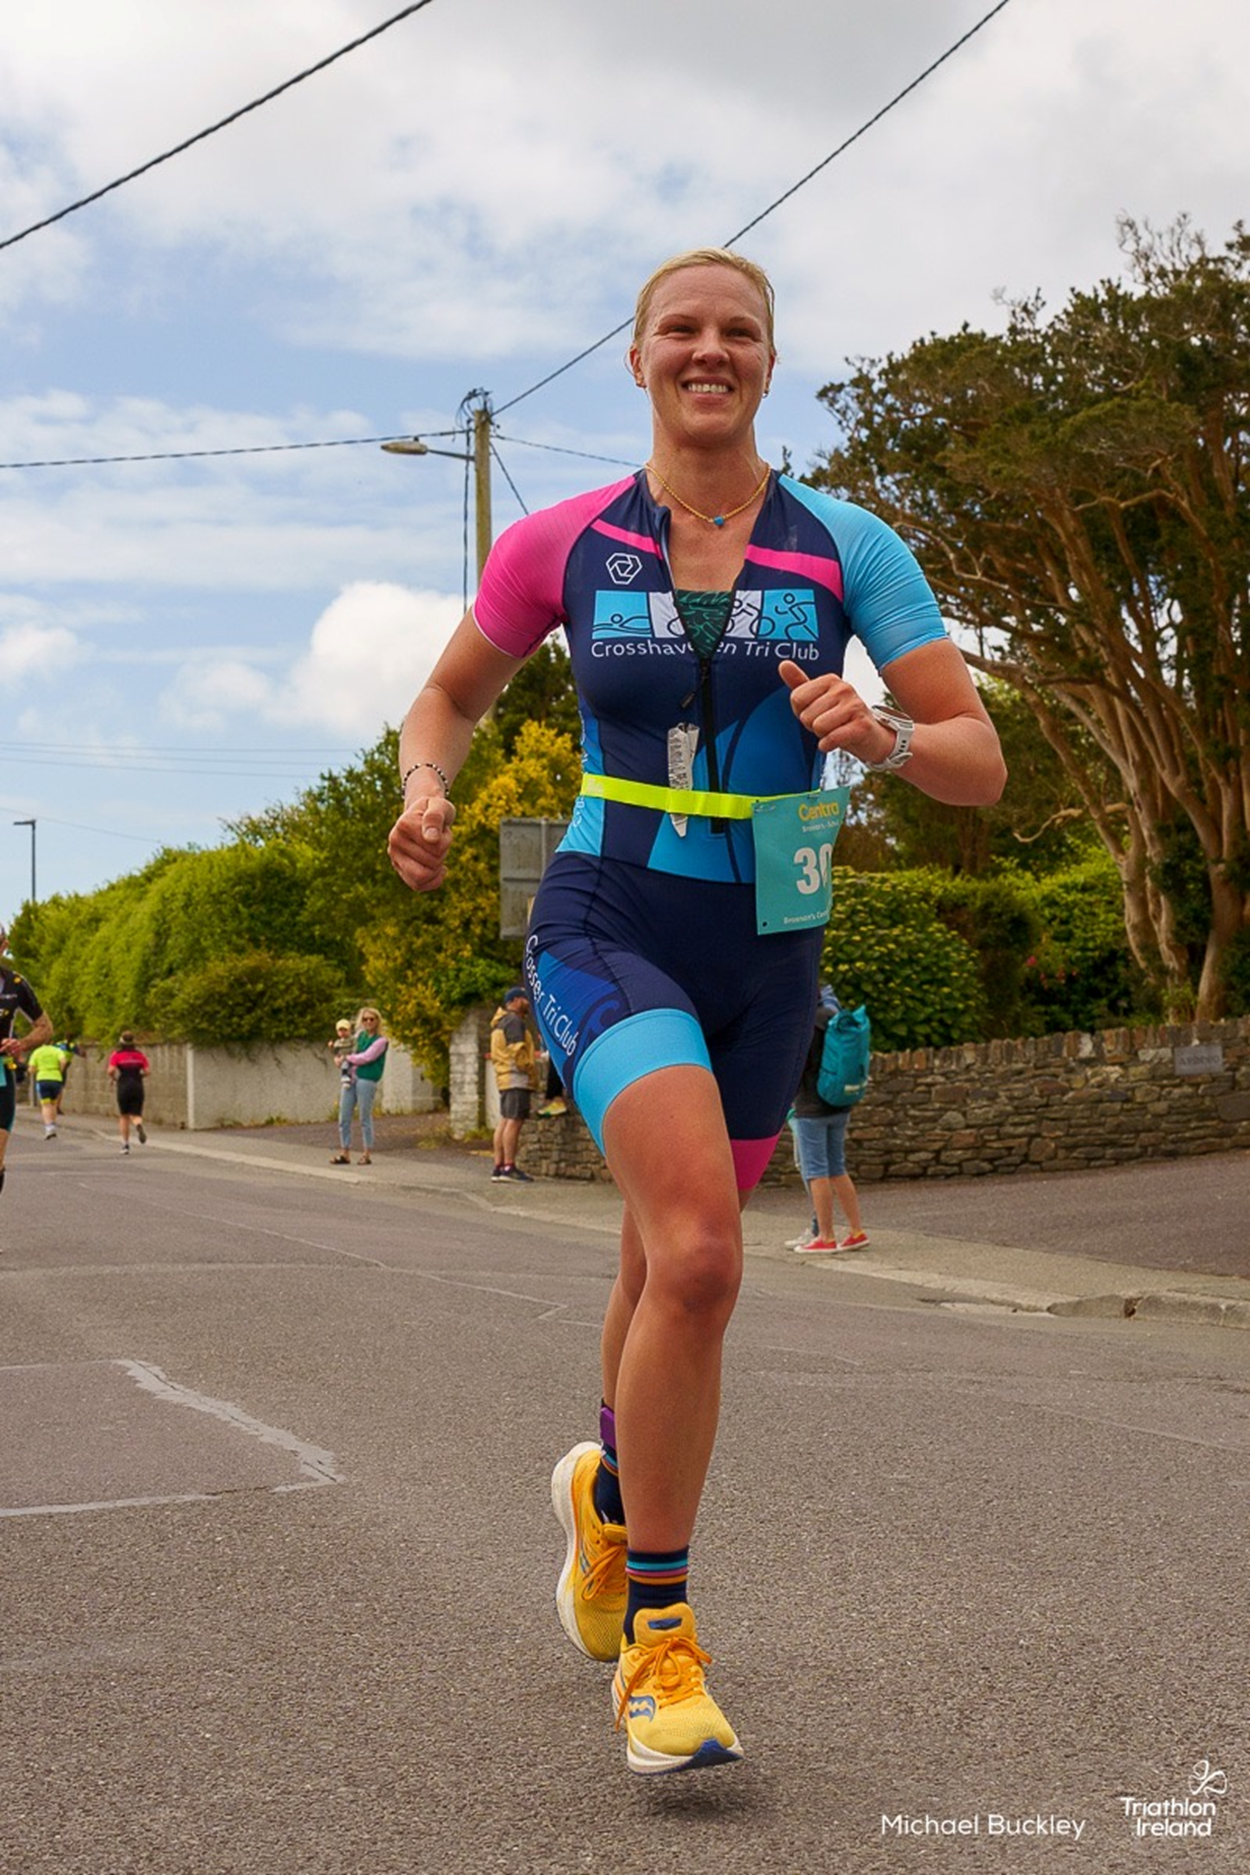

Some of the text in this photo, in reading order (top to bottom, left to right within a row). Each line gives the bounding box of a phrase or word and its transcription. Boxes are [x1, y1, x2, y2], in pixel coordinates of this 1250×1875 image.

[744, 641, 769, 657] Tri
[775, 642, 819, 661] Club
[543, 994, 561, 1023] Tri
[554, 1014, 579, 1055] Club
